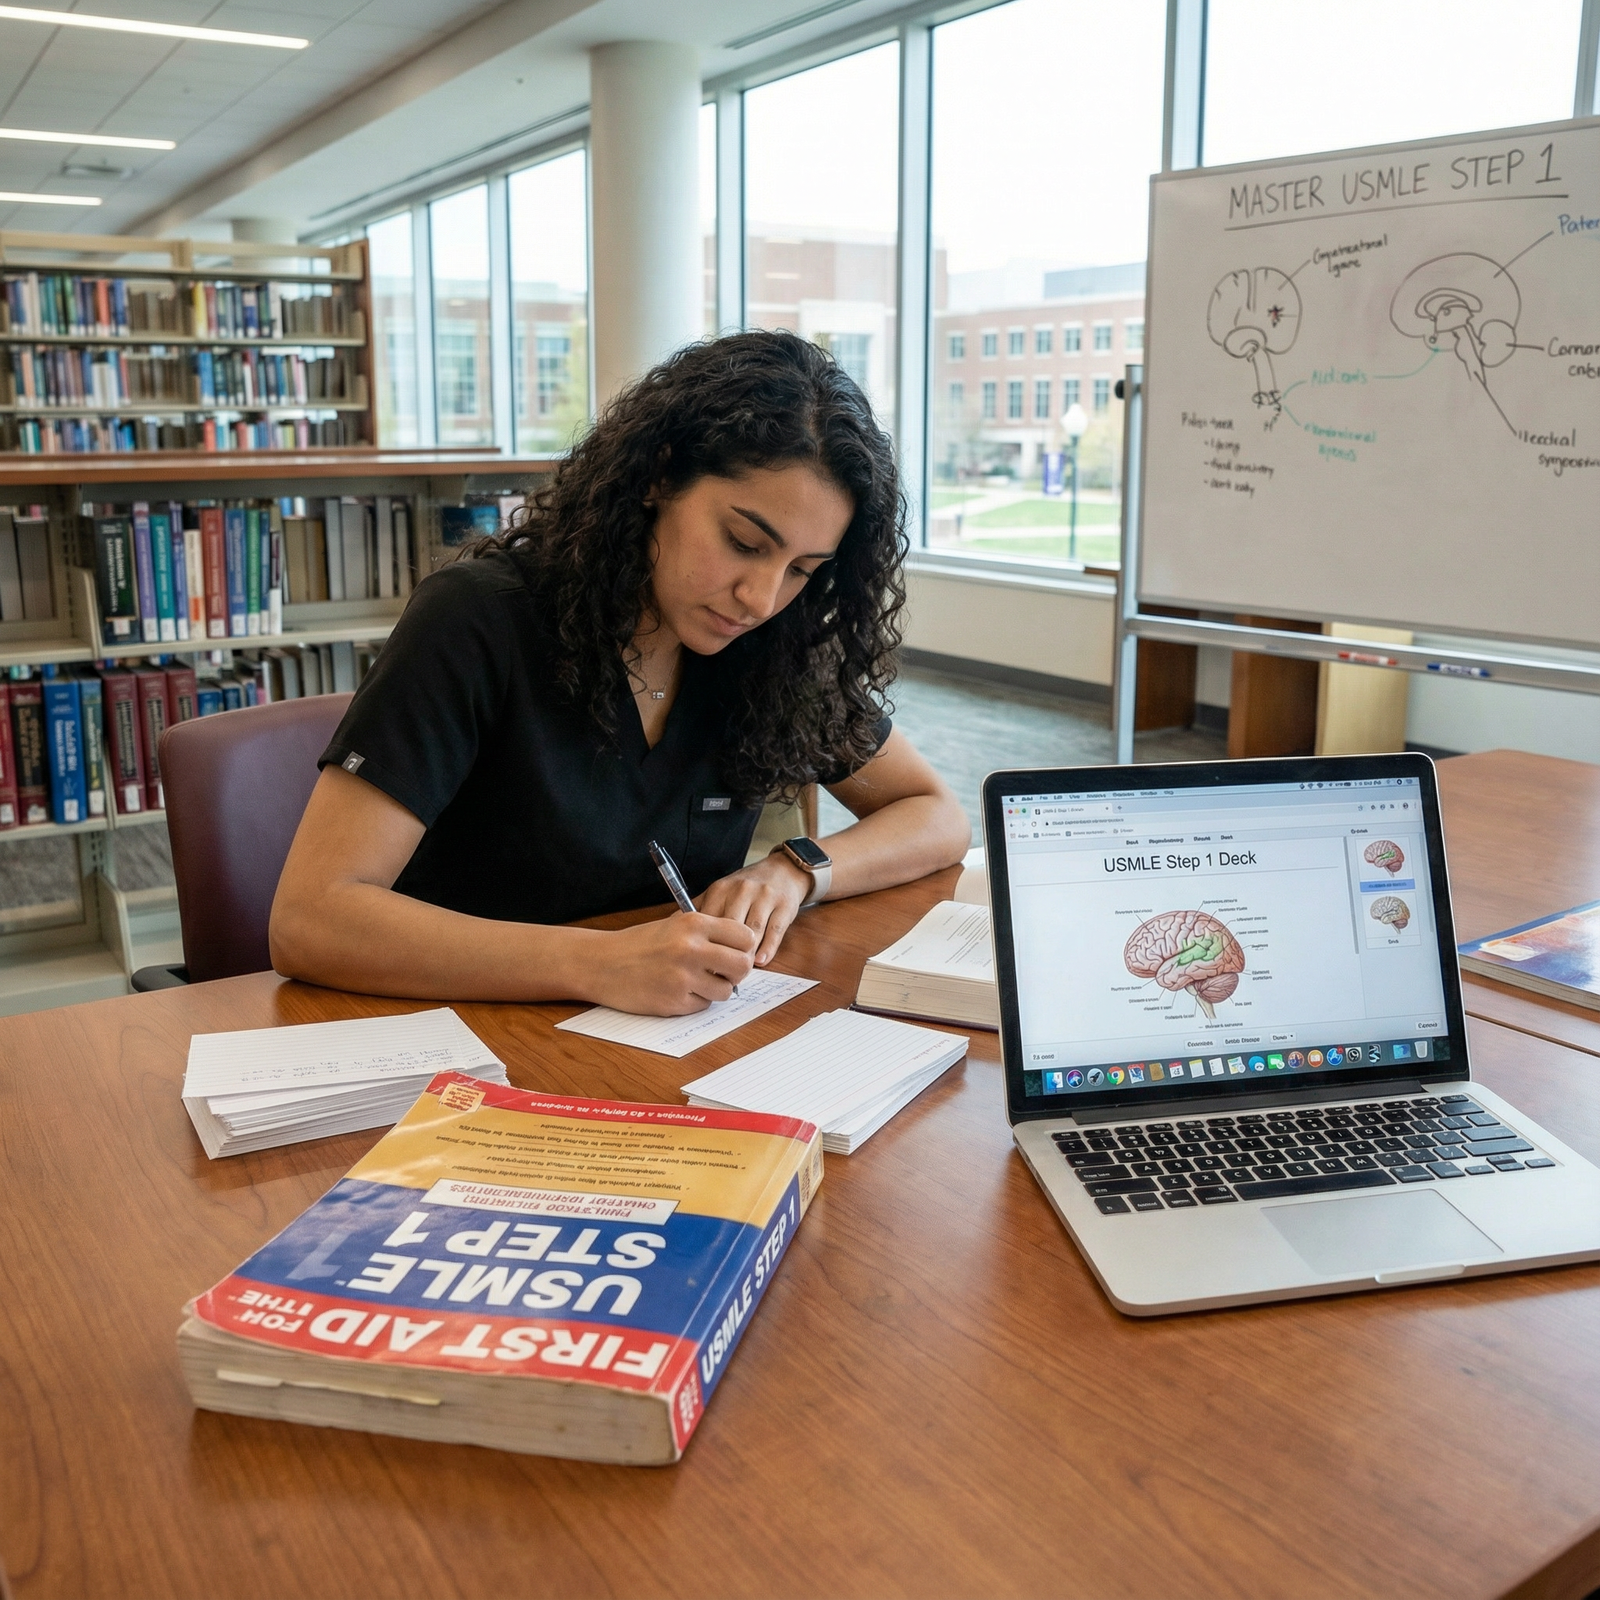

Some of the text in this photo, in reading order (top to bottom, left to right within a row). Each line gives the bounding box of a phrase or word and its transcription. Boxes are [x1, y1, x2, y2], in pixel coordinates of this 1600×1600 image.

[1228, 142, 1562, 219] MASTER USMLE STEP 1
[1103, 850, 1257, 873] USMLE Step 1 Deck
[383, 1211, 668, 1269] STEP 1
[348, 1252, 644, 1316] USMLE
[701, 1195, 796, 1384] USMLE STEP 1
[309, 1308, 670, 1378] FIRST AID
